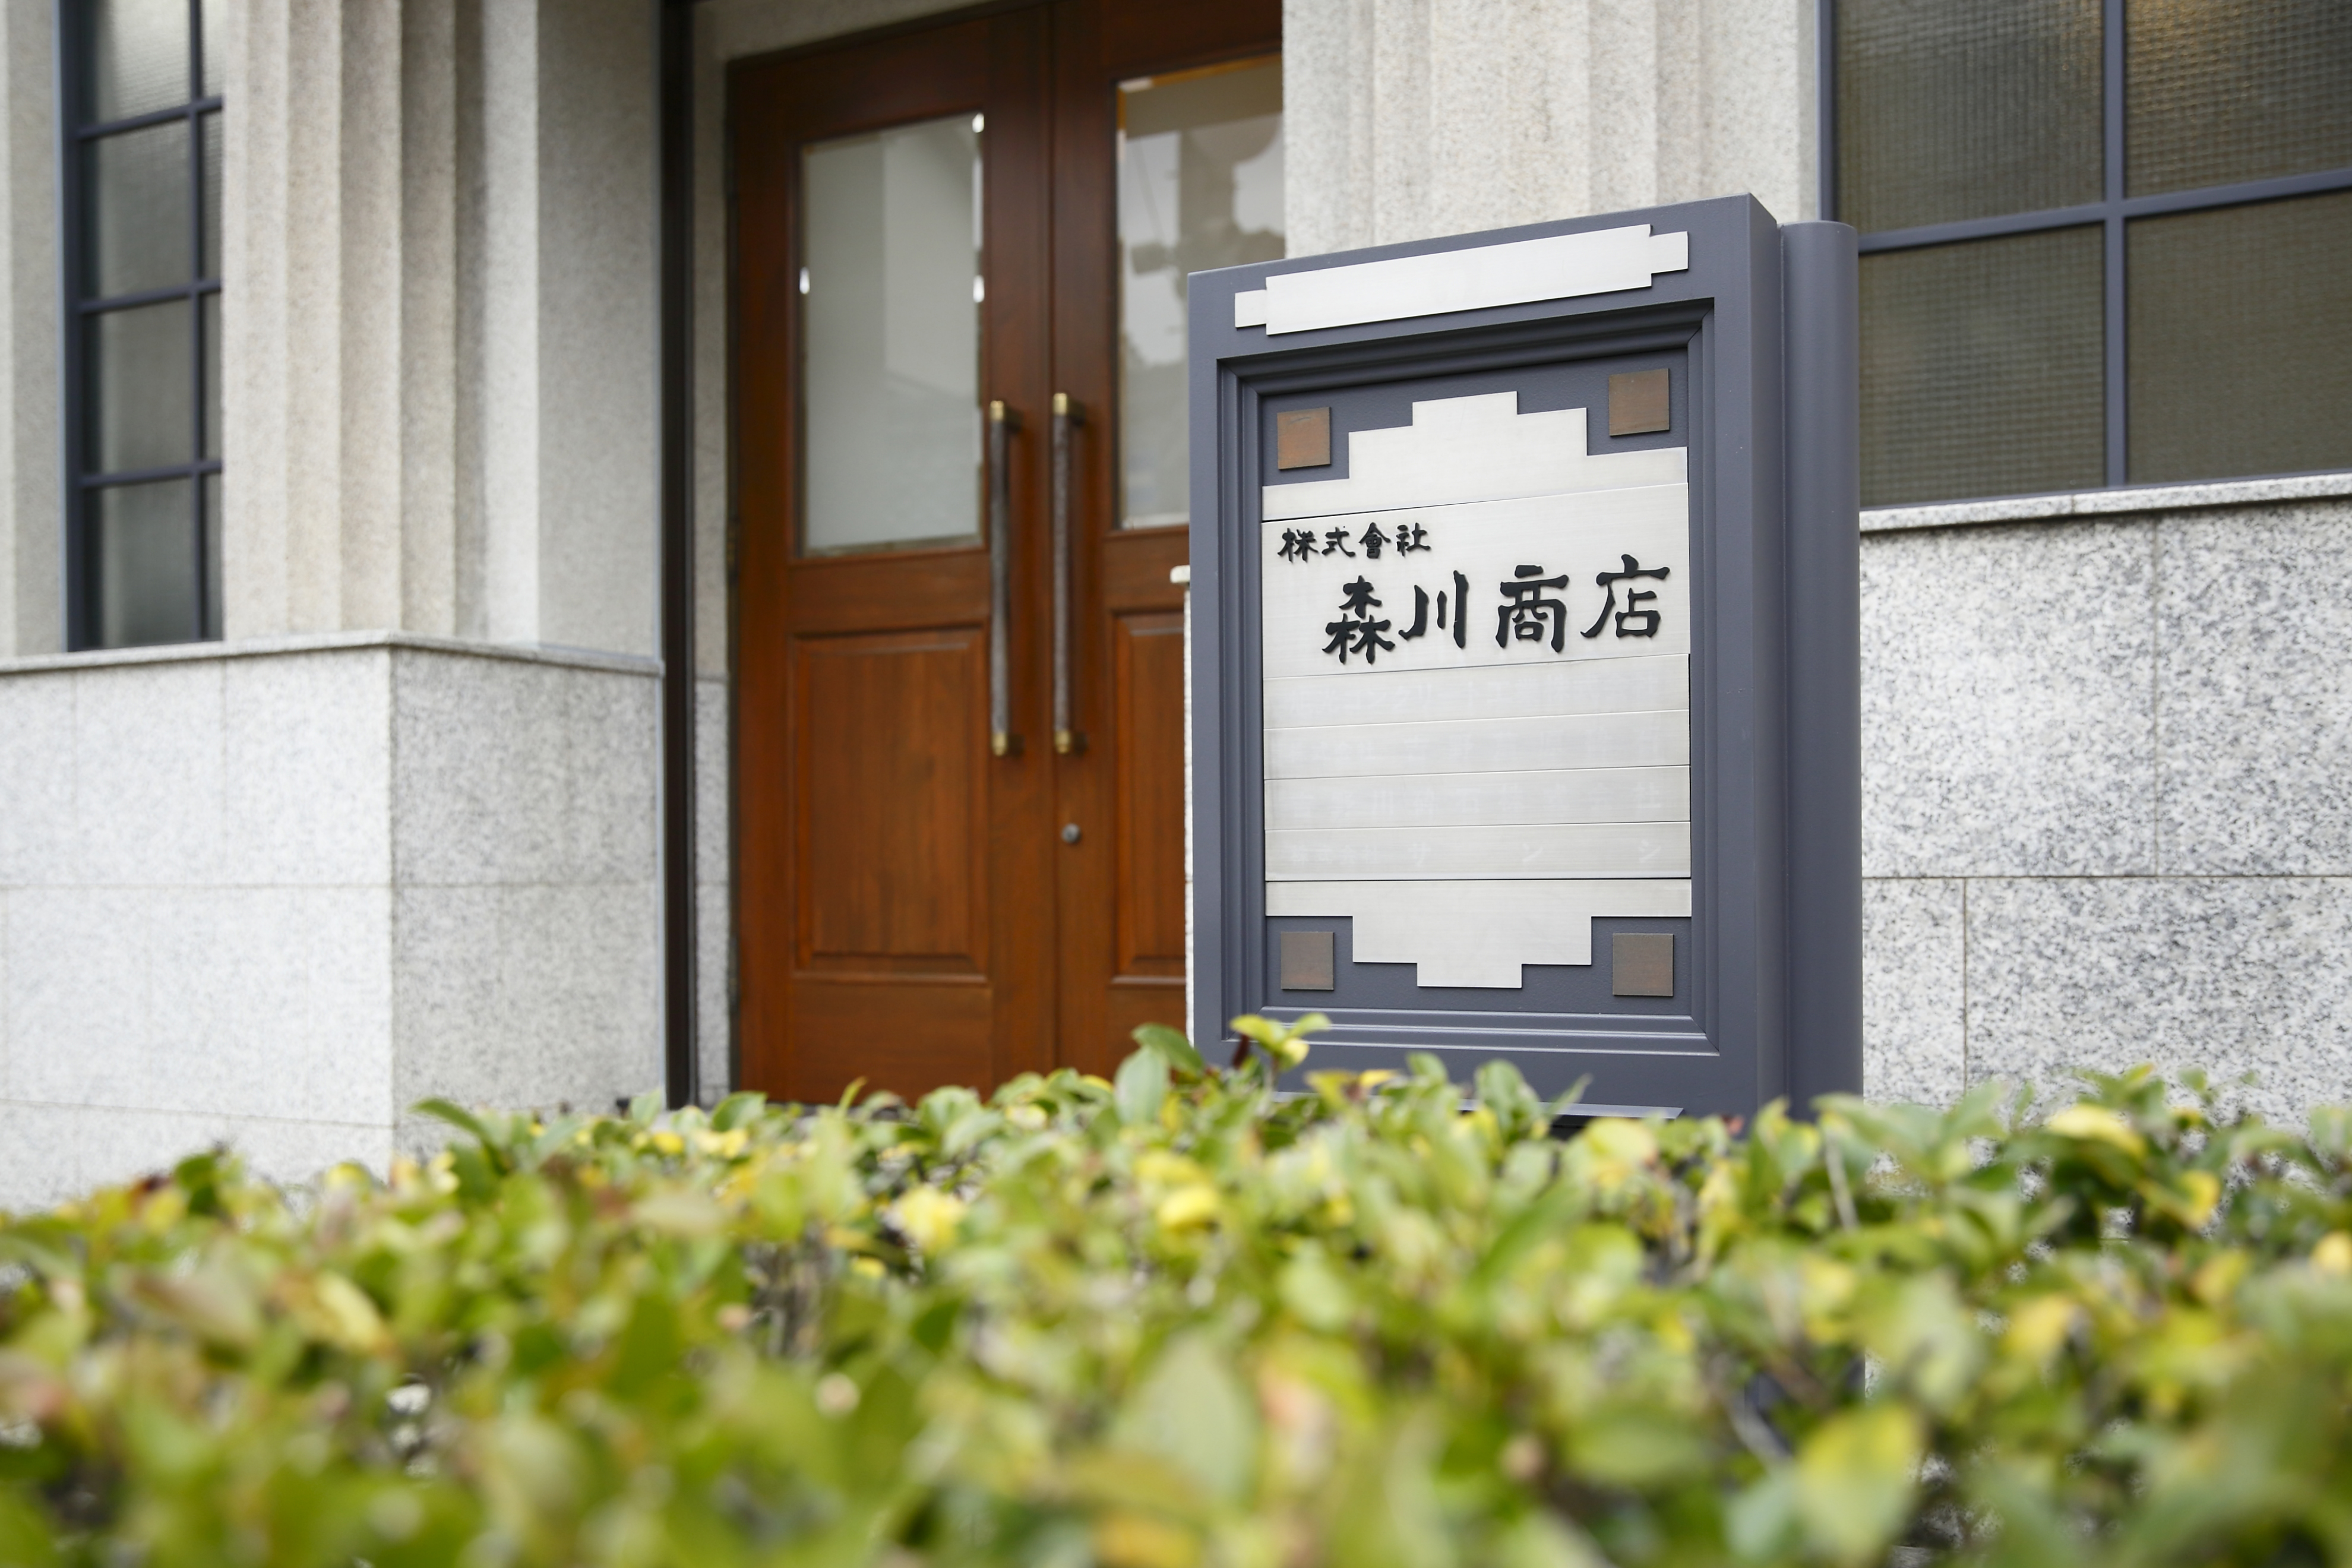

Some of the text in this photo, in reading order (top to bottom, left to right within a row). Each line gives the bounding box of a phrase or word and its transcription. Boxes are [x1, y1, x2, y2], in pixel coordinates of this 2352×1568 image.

[1277, 522, 1431, 562] 株式會社
[1322, 554, 1671, 665] 森川商店
